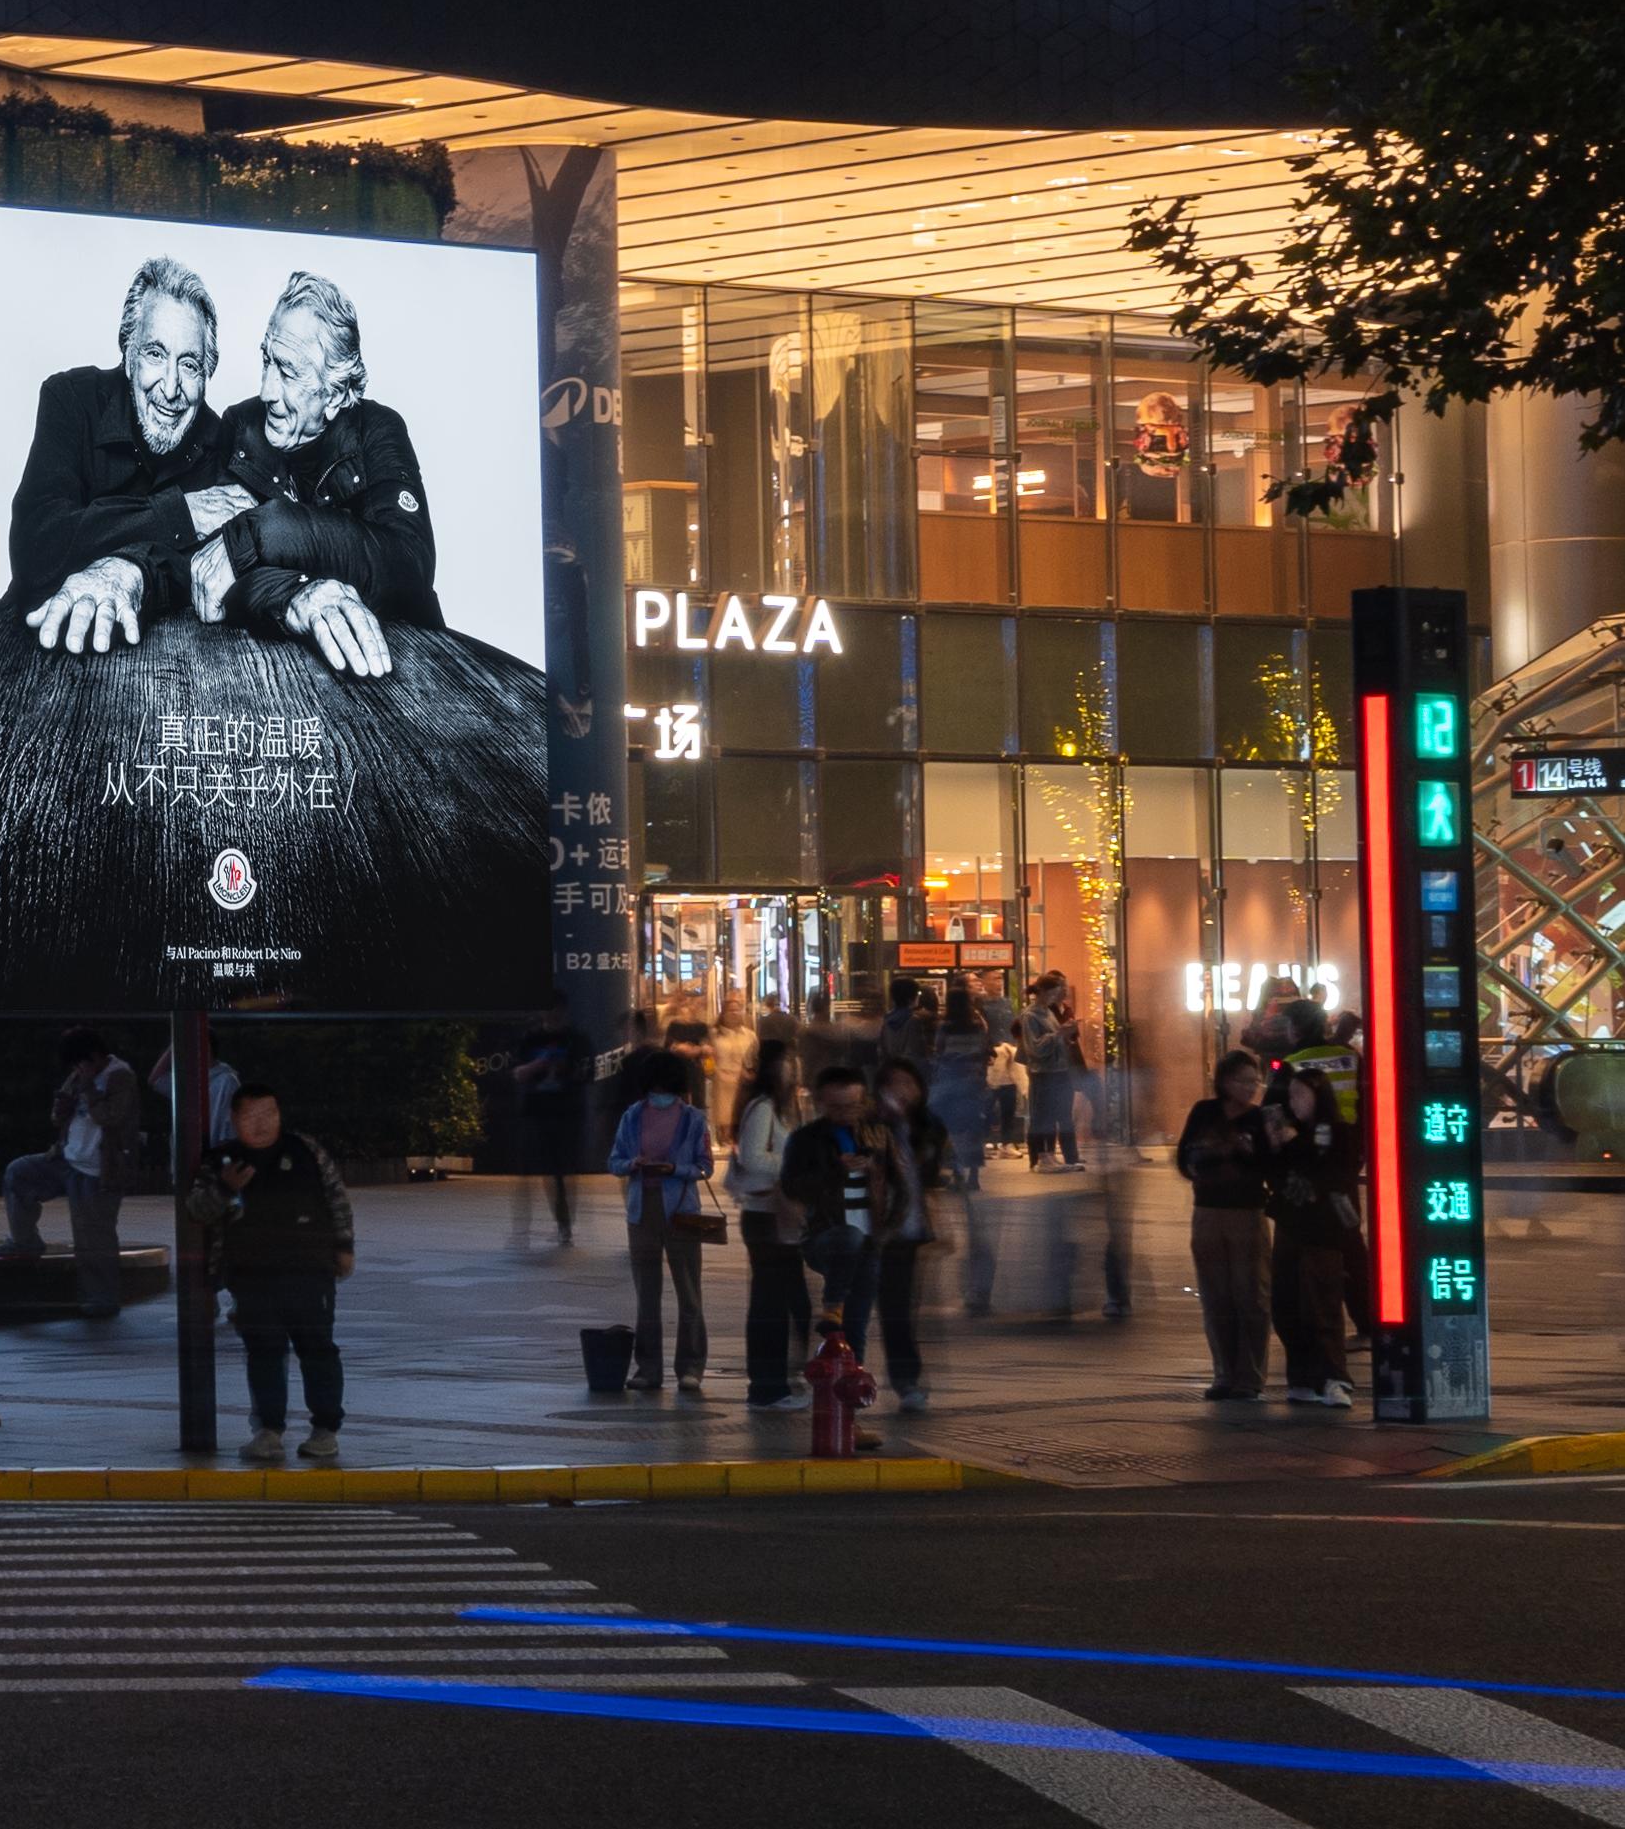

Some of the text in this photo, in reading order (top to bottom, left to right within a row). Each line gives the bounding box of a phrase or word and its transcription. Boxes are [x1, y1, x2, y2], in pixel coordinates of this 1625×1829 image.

[635, 590, 844, 655] PLAZA
[156, 712, 323, 761] 真正的温暖
[100, 761, 336, 811] 从不只关乎外在
[1517, 757, 1603, 789] 1 14 号线
[215, 881, 251, 901] MONCLER
[213, 963, 256, 978] 温暖与共
[565, 952, 592, 971] B2
[1423, 1101, 1470, 1144] 遵守
[1425, 1180, 1472, 1223] 交通
[1429, 1256, 1477, 1303] 信号
